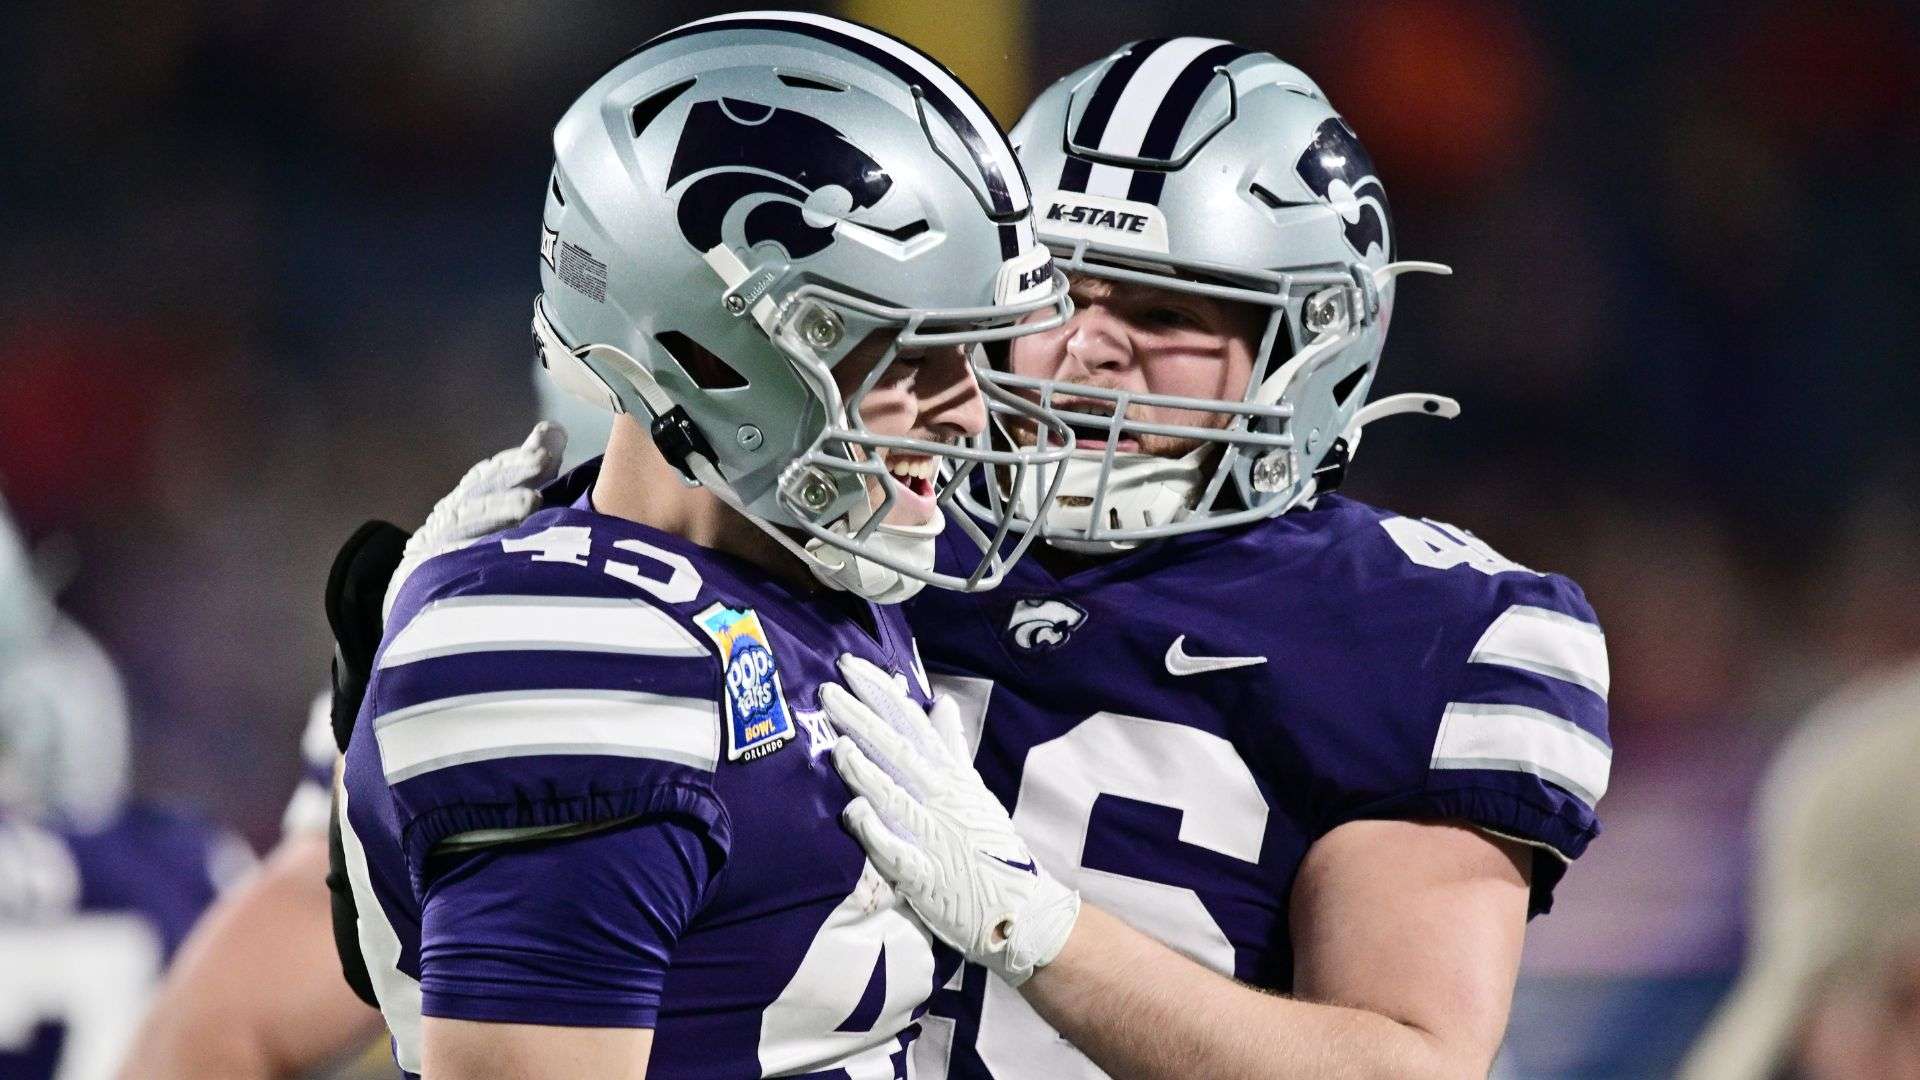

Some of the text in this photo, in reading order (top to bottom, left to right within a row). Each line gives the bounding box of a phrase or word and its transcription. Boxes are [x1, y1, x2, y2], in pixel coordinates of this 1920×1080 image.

[1046, 203, 1149, 234] K-STATE
[745, 718, 776, 743] BOWL
[744, 740, 783, 761] ORLANDO
